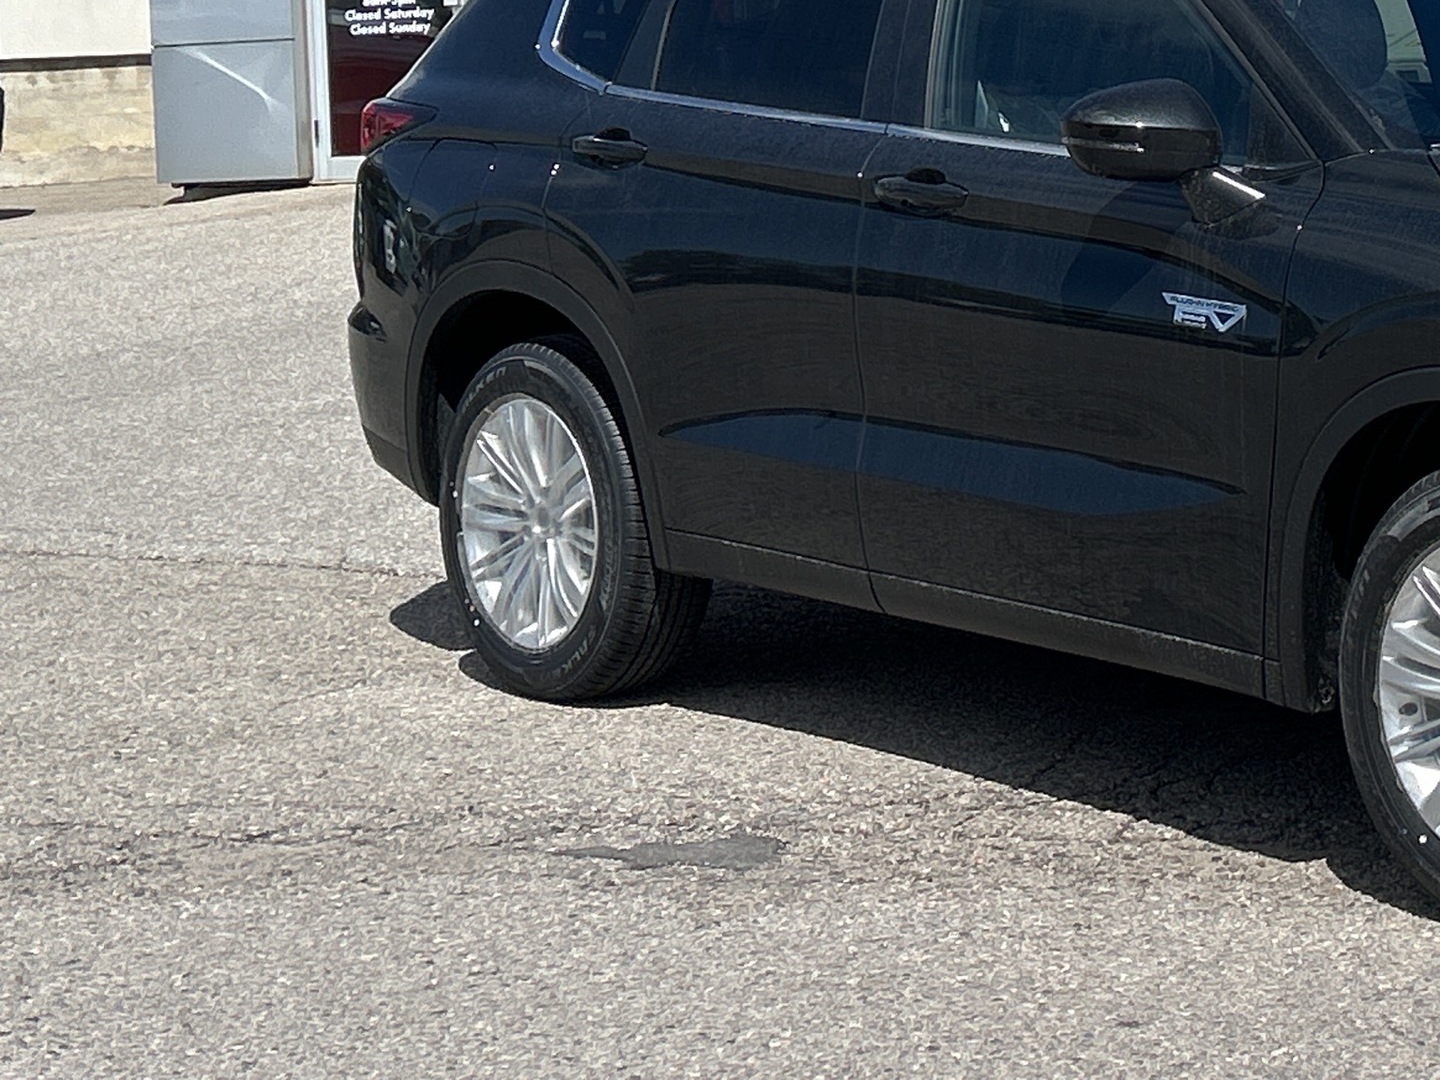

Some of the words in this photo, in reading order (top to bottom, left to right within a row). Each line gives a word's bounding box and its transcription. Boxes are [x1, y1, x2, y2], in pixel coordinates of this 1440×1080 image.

[344, 8, 381, 21] Closed
[384, 6, 435, 20] Saturday
[350, 21, 387, 35] Closed
[389, 21, 431, 35] Sunday
